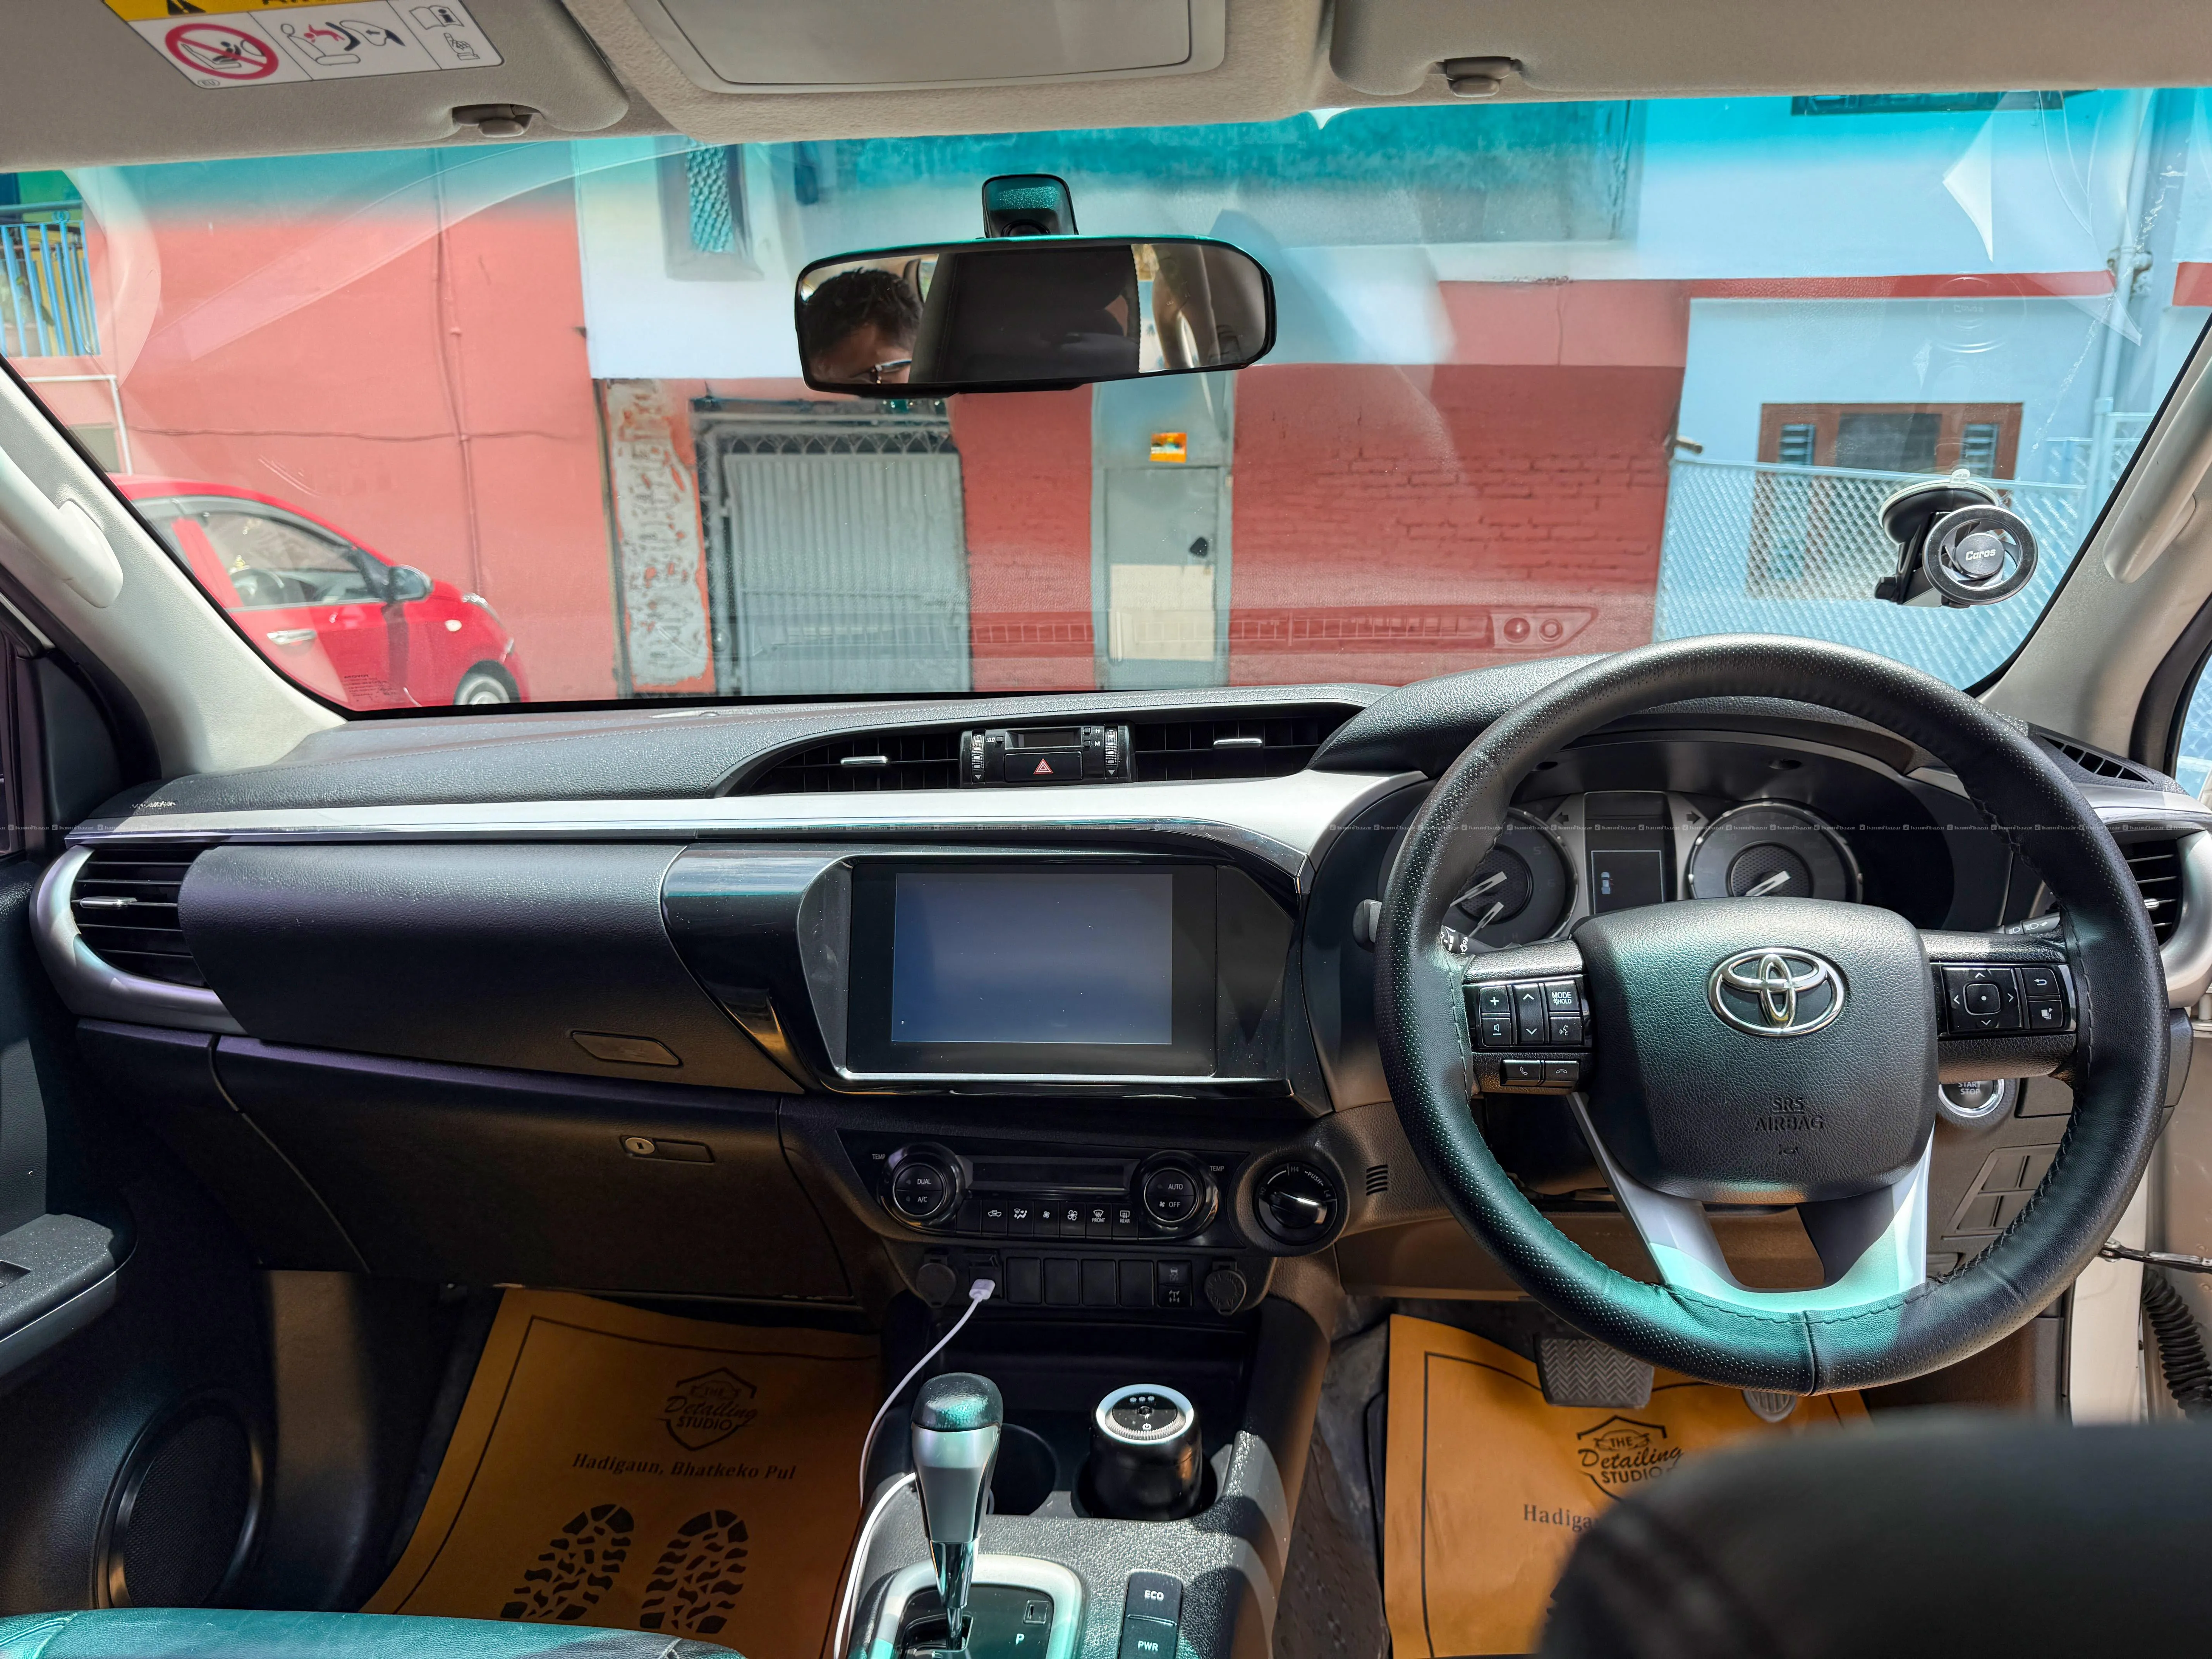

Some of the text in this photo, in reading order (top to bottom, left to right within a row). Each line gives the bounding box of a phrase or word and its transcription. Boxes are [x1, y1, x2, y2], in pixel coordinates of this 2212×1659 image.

[1965, 548, 1996, 561] Caros
[1772, 1097, 1804, 1112] SRS
[1753, 1116, 1824, 1131] AIRBAG
[664, 1396, 758, 1422] Detailing
[676, 1416, 732, 1431] STUDIO
[1610, 1436, 1633, 1448] THE
[1578, 1446, 1684, 1470] Detailing
[572, 1454, 796, 1479] Hadigaun, Bhatkeko Pul
[1601, 1466, 1663, 1484] STUDIO
[1523, 1504, 1592, 1532] Hadiga
[1144, 1590, 1164, 1601] ECO
[1015, 1633, 1025, 1645] P
[1138, 1640, 1159, 1651] PWR
